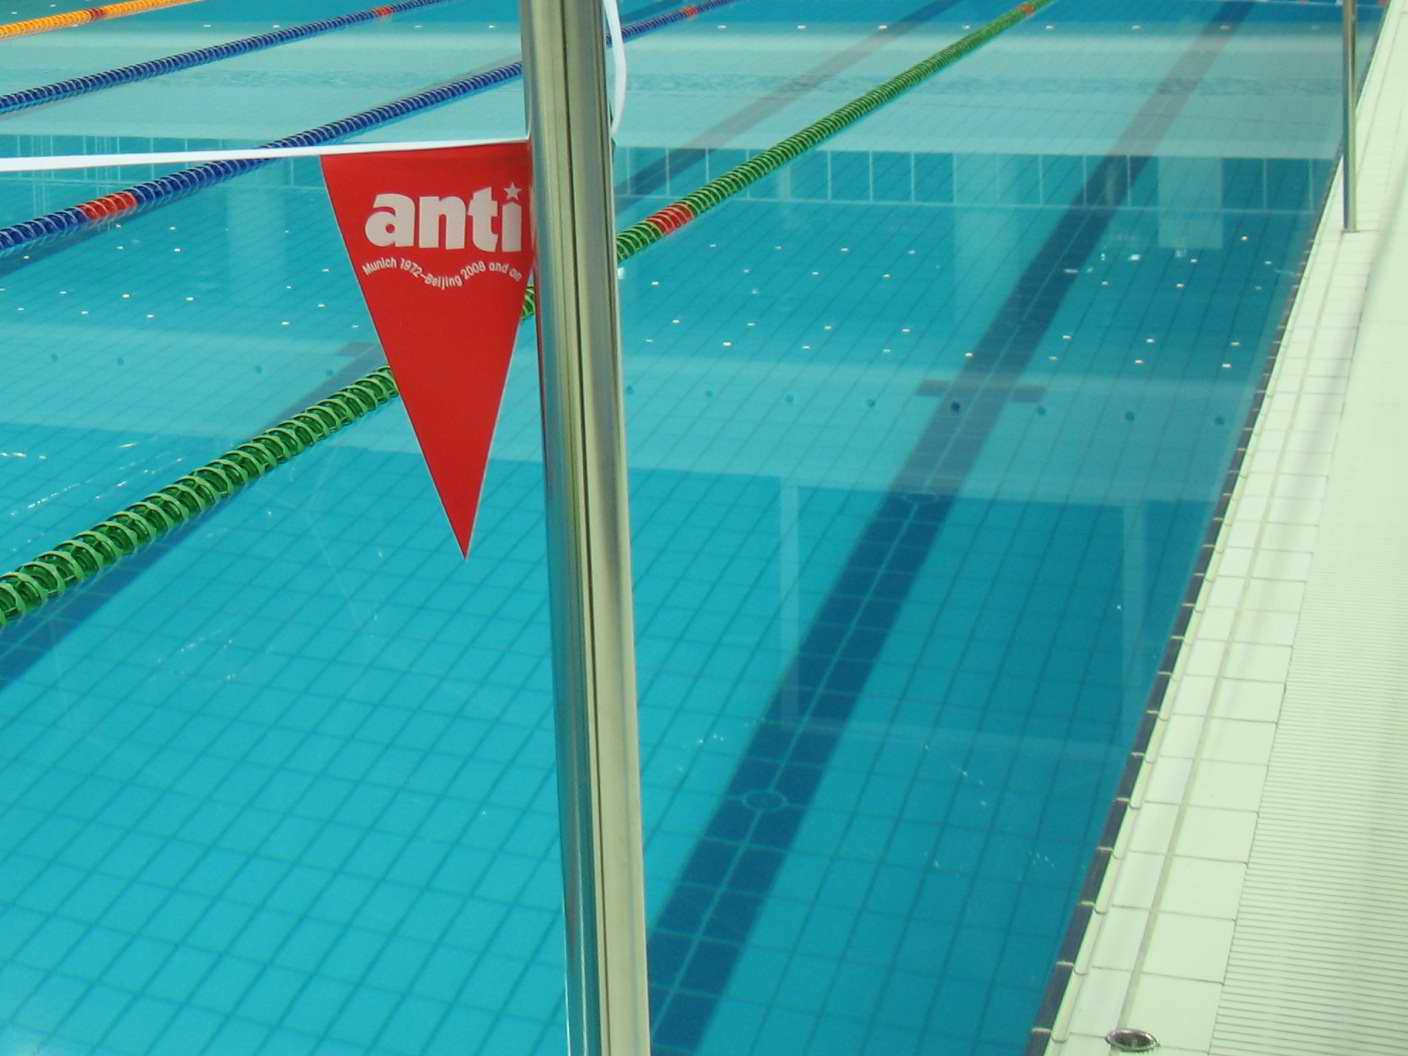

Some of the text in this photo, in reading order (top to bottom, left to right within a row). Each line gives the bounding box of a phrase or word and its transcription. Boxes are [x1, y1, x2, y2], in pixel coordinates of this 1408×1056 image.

[365, 182, 522, 253] anti
[362, 257, 397, 275] Munich
[460, 260, 486, 280] 2008
[489, 262, 510, 273] and
